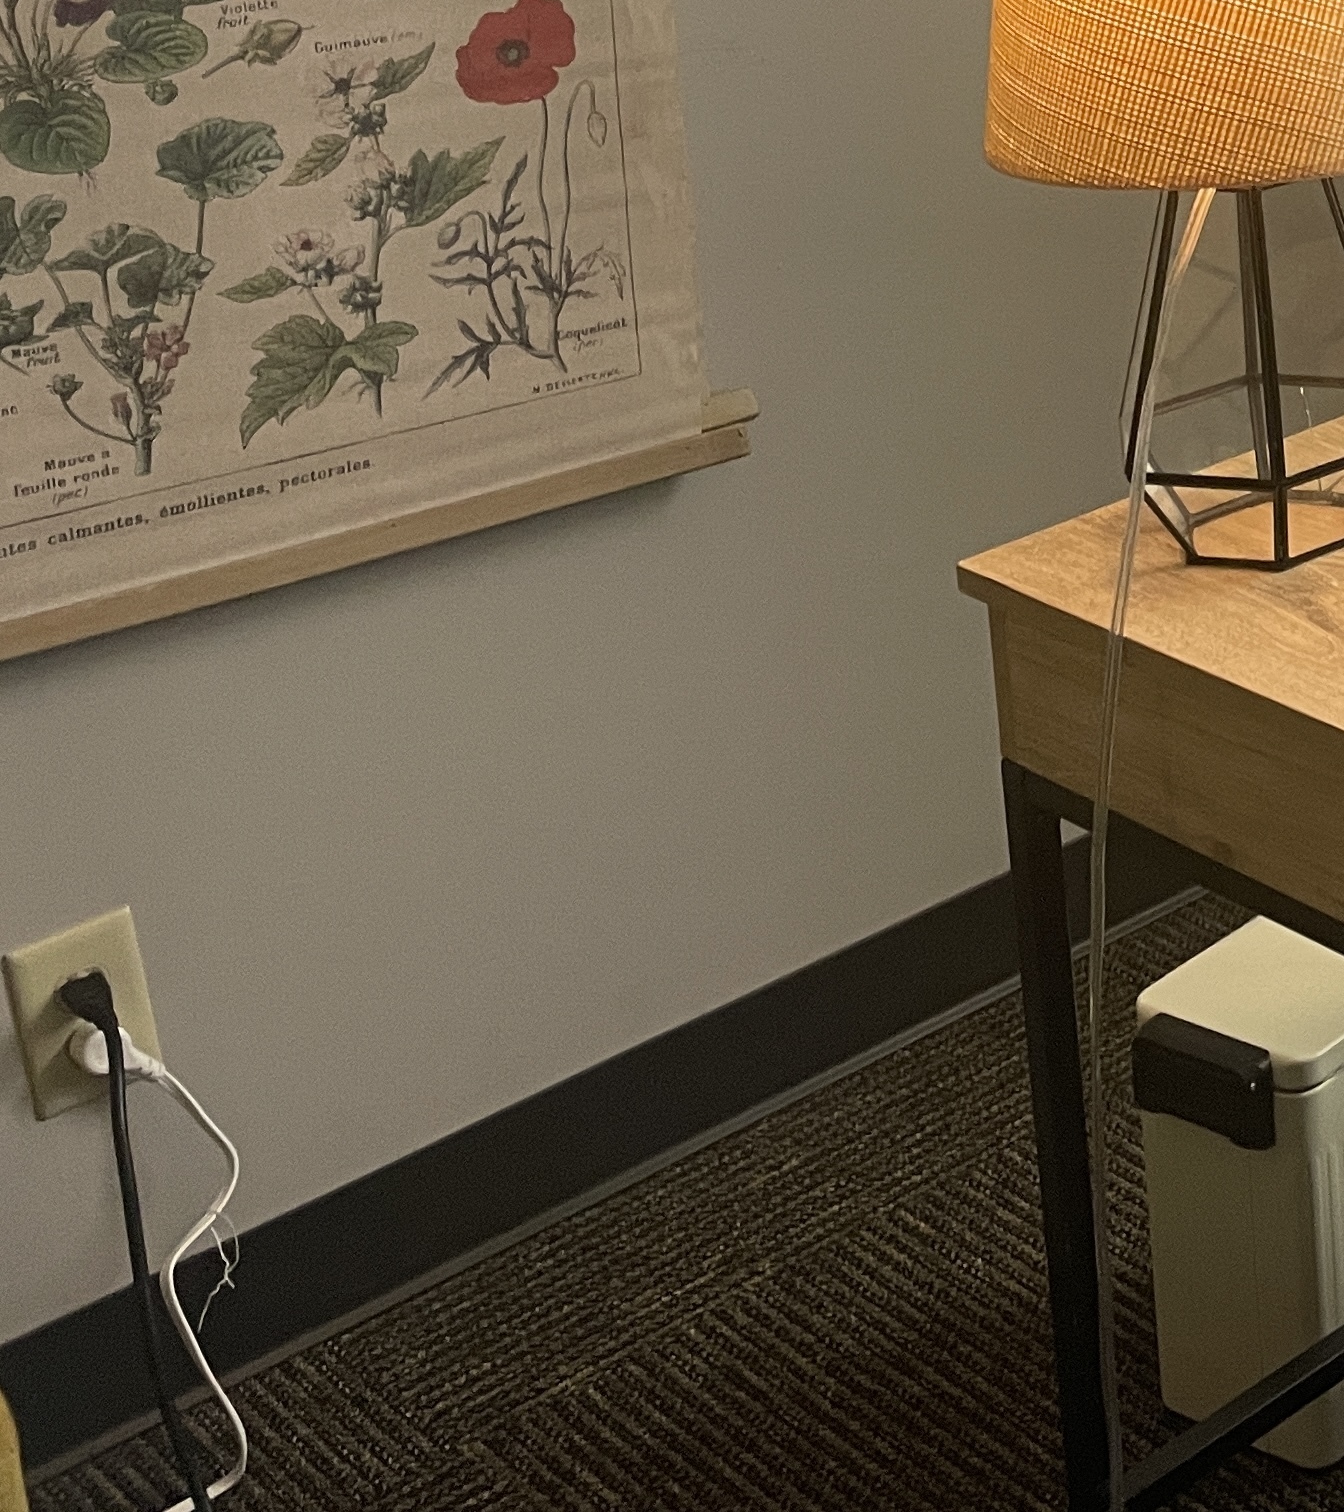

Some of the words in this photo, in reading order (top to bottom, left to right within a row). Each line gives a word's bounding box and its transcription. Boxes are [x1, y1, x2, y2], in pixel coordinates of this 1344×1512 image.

[43, 452, 96, 472] Mauve
[13, 476, 67, 498] feuille
[73, 464, 121, 484] ronde
[47, 514, 150, 546] calmantes,
